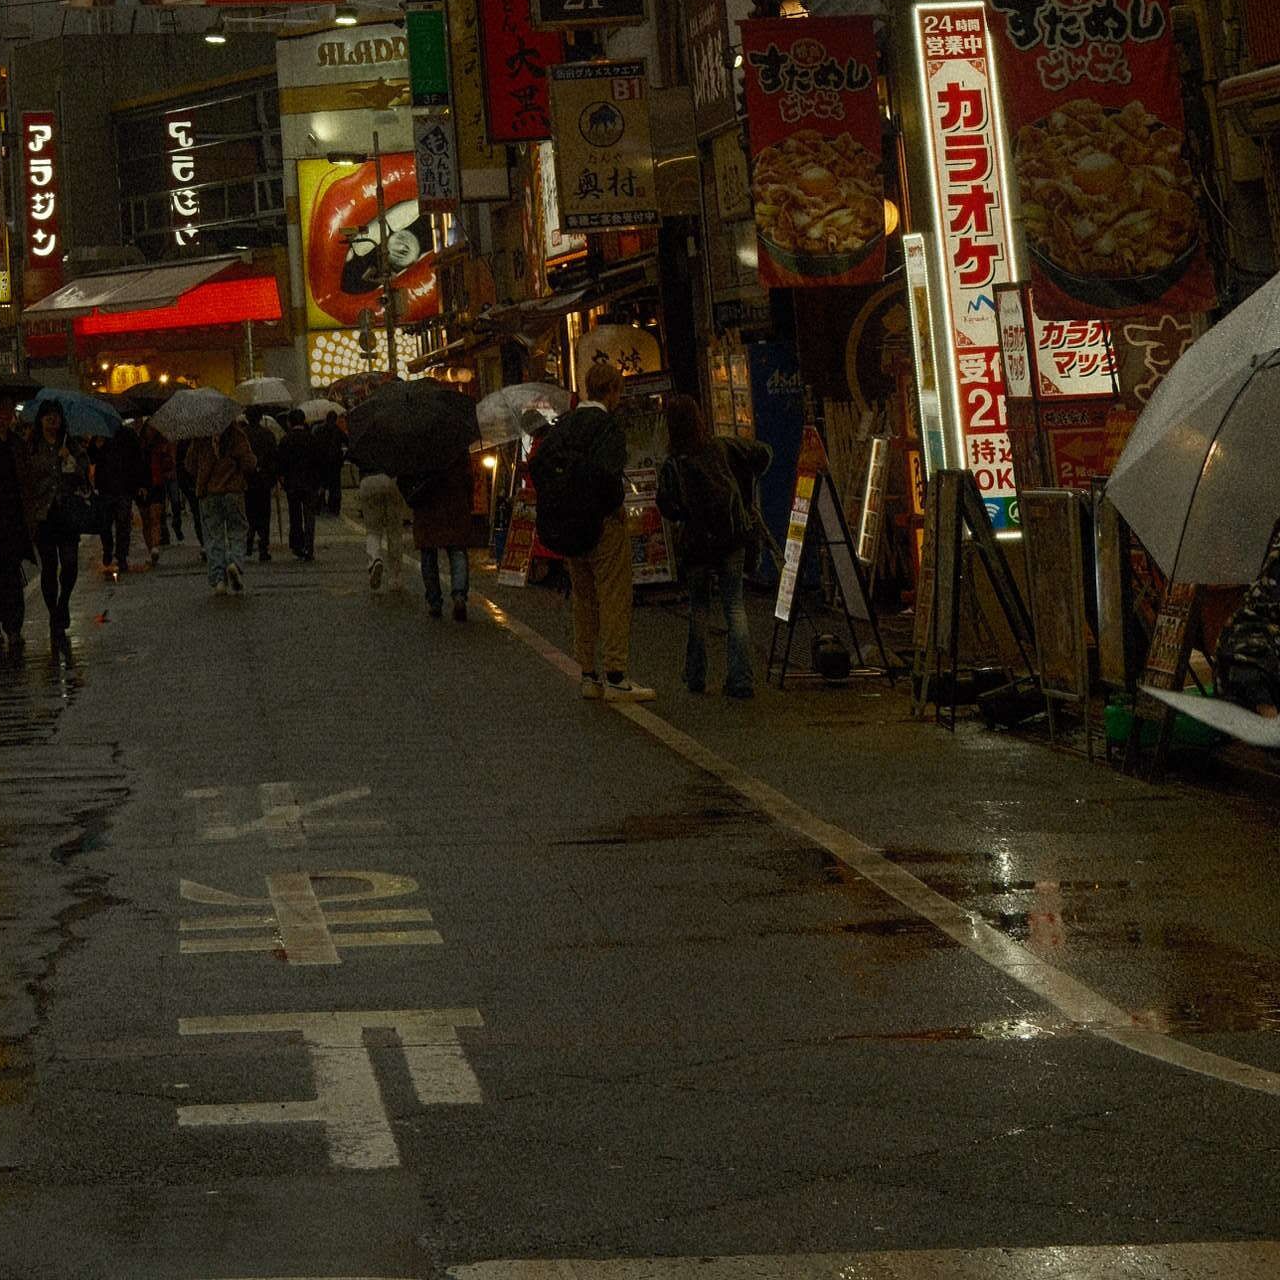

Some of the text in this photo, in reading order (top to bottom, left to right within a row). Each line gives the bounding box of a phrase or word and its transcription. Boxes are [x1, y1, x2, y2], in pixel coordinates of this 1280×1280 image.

[923, 16, 981, 35] 24時間
[926, 35, 982, 56] 営業中
[613, 78, 642, 101] B1
[28, 124, 56, 256] アラジン
[937, 82, 1003, 289] カラオケ
[976, 469, 1017, 492] OK
